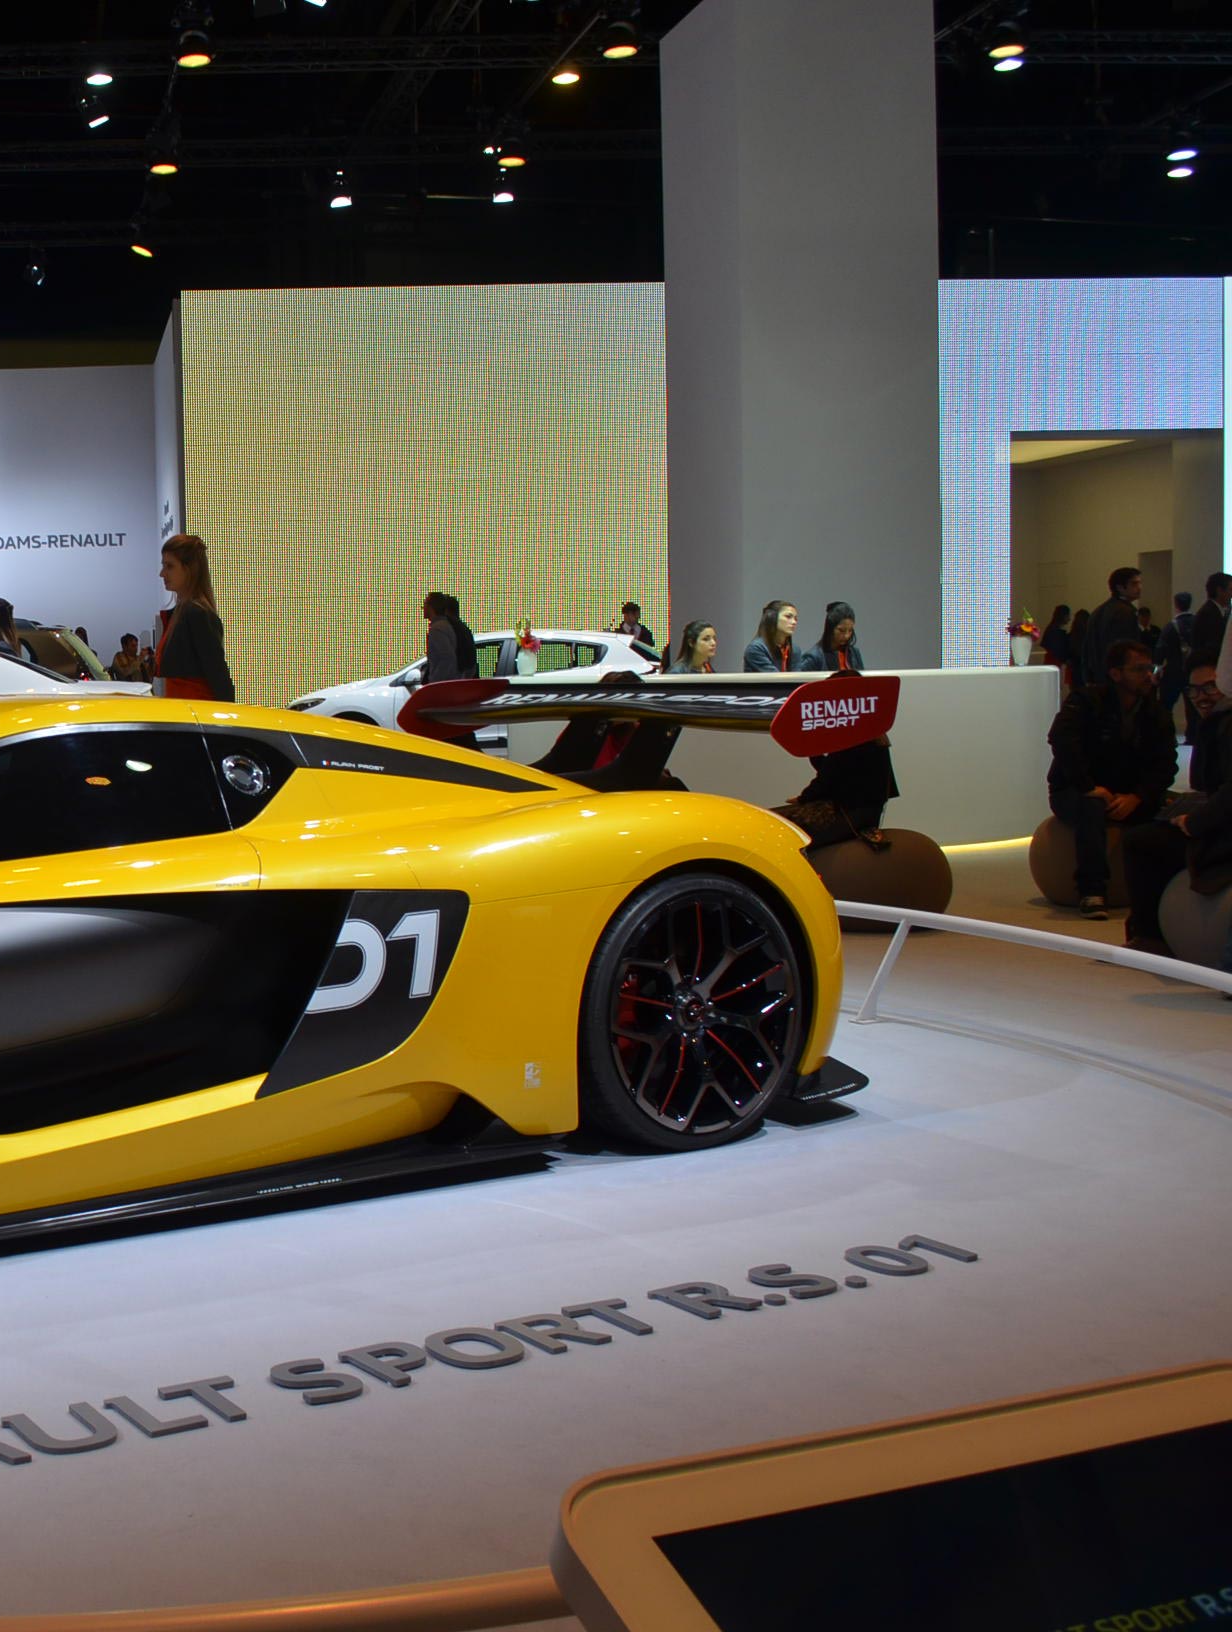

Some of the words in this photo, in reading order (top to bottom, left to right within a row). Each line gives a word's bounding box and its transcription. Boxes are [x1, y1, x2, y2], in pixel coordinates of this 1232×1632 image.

[480, 693, 667, 705] RENAULT
[800, 696, 879, 719] RENAULT
[801, 715, 860, 731] SPORT
[269, 1297, 655, 1406] SPORT
[647, 1233, 979, 1320] R.S.01
